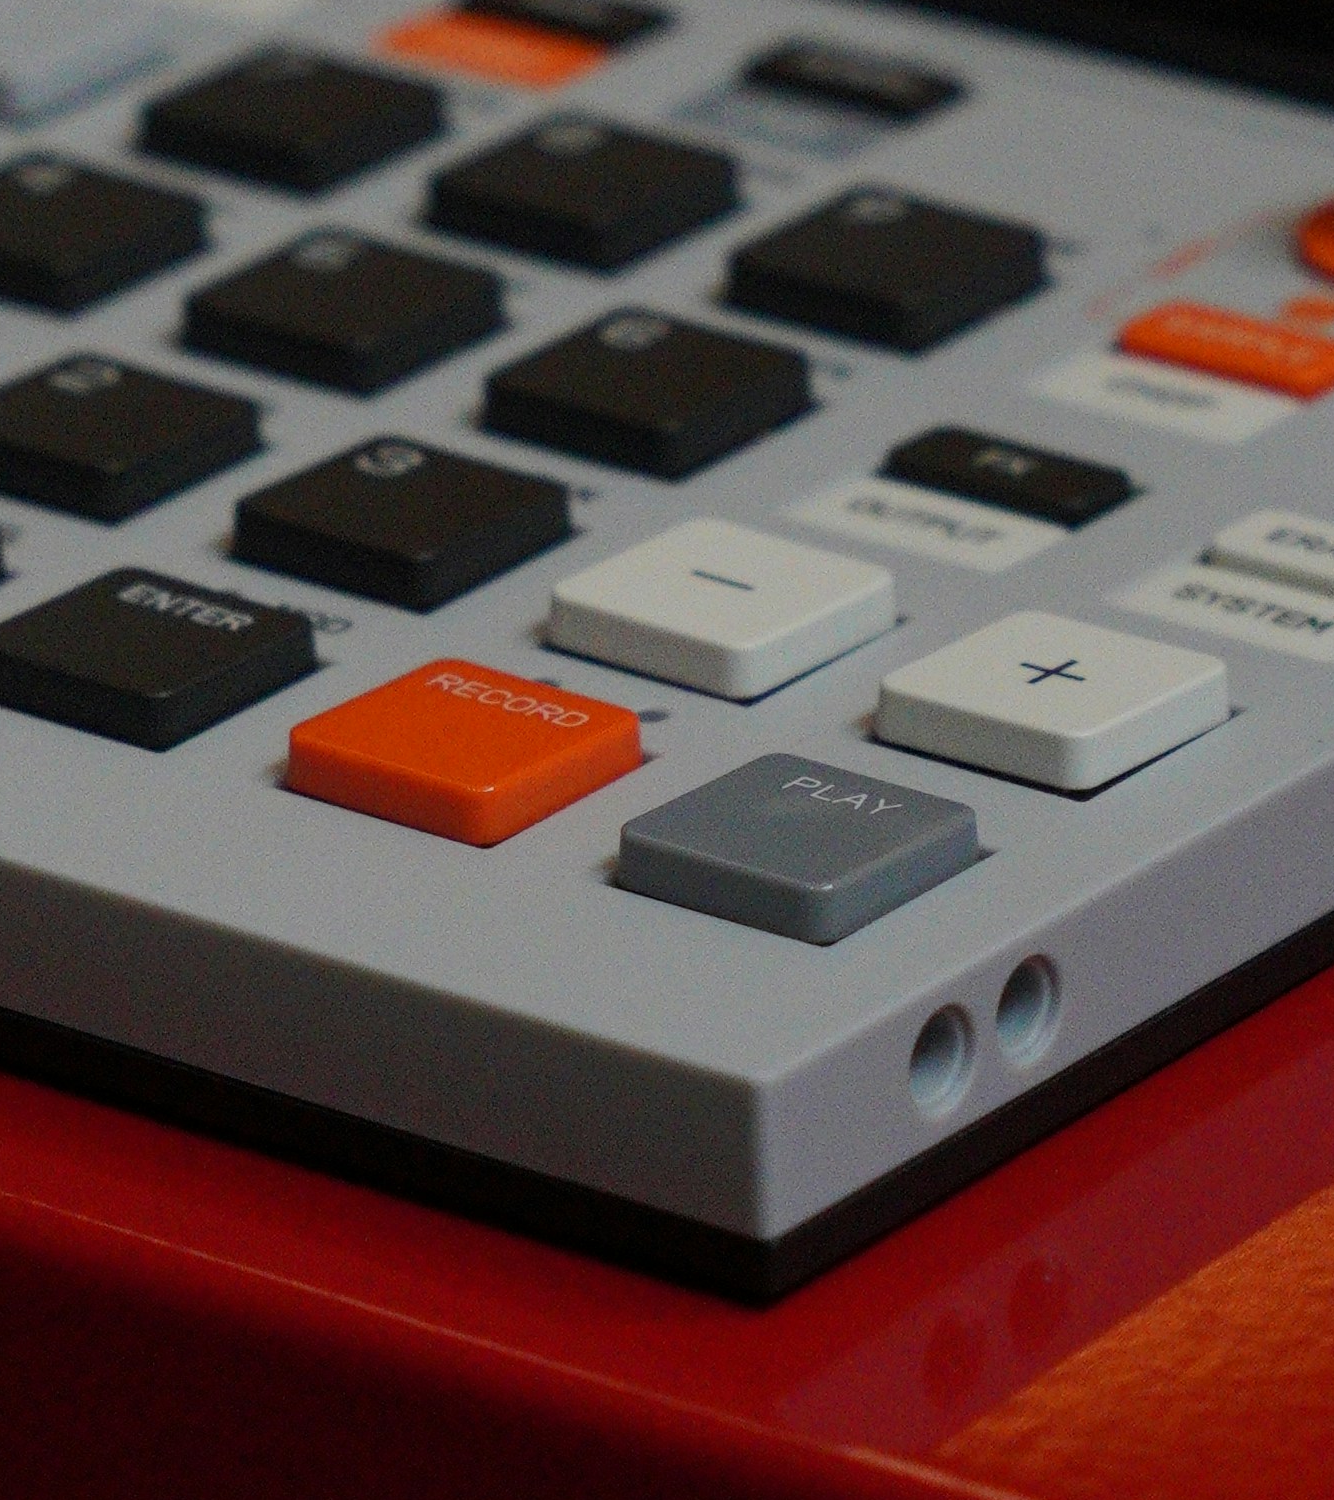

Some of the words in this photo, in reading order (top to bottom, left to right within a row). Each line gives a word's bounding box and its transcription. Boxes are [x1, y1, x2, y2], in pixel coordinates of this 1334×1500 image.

[353, 442, 426, 479] 3
[847, 497, 1009, 544] OUTPUT
[119, 582, 256, 633] ENTER
[425, 669, 592, 731] RECORD
[781, 772, 905, 818] PLAY
